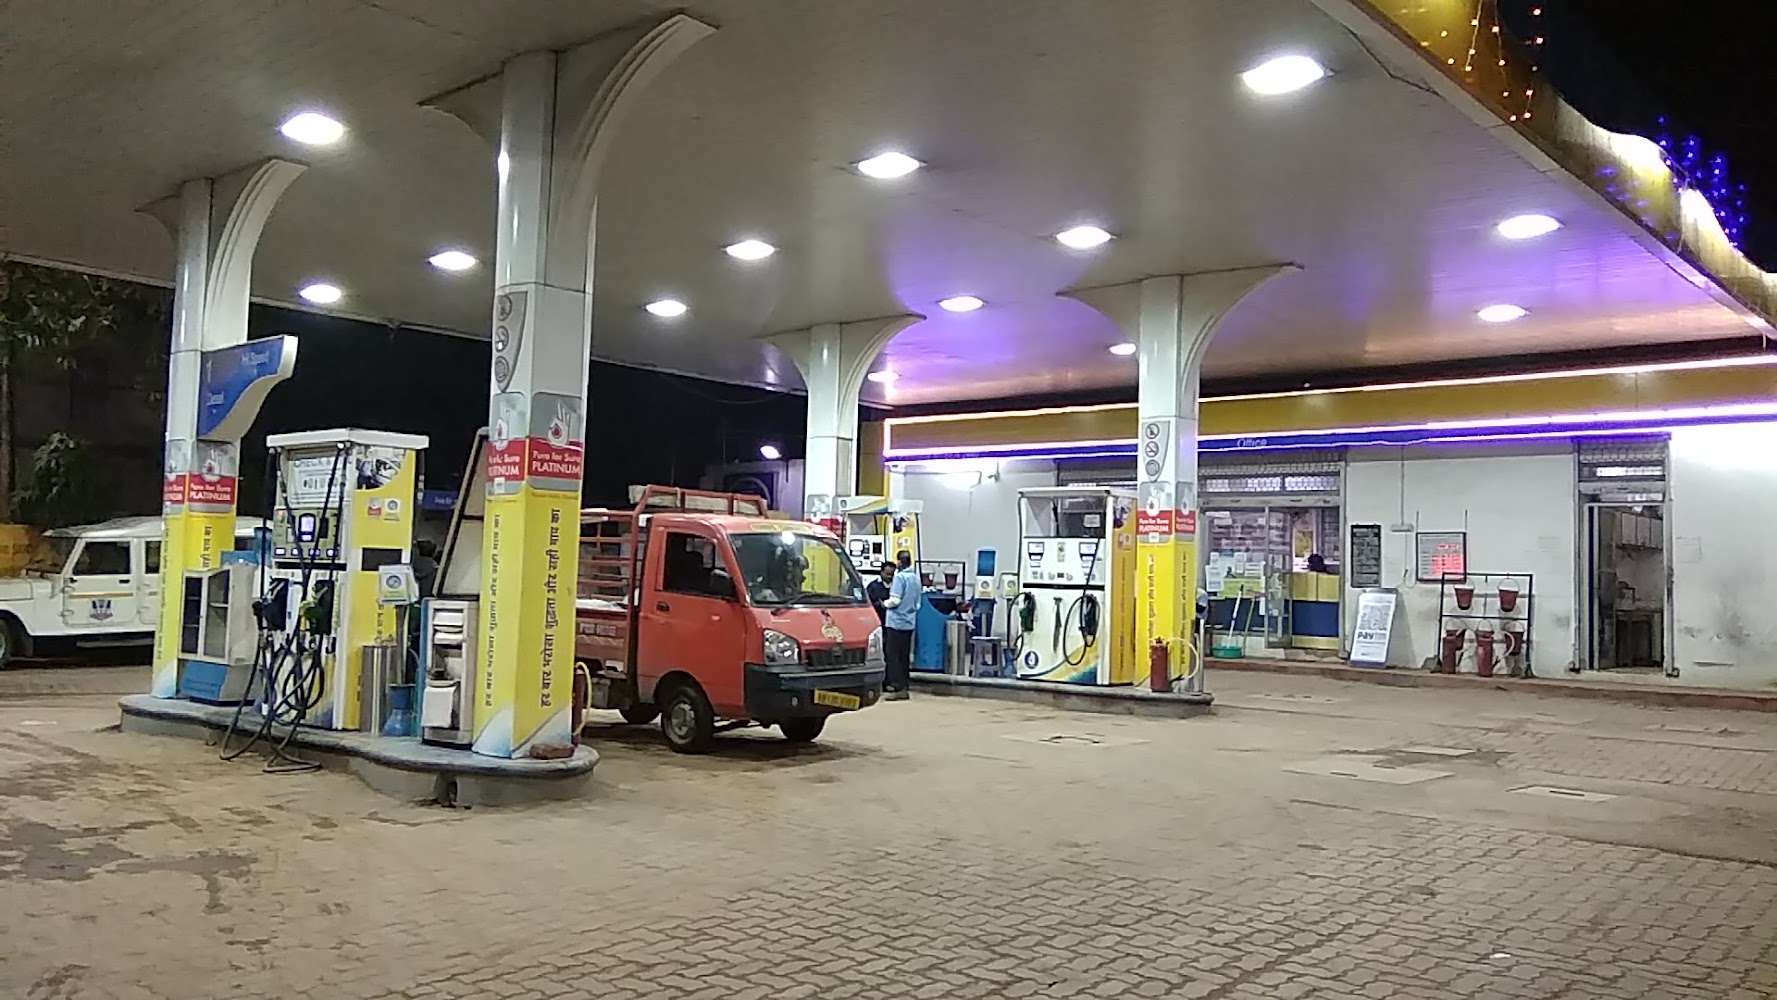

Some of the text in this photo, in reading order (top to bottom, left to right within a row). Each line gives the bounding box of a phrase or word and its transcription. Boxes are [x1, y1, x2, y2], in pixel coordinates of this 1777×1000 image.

[1237, 438, 1267, 448] Office
[533, 450, 581, 463] Pure for Sure
[532, 461, 580, 475] PLATINUM
[189, 491, 231, 501] PLATINUM
[551, 509, 560, 523] का
[546, 549, 560, 570] सही
[544, 574, 557, 593] और
[540, 634, 554, 667] भरोसा
[540, 693, 551, 707] हर
